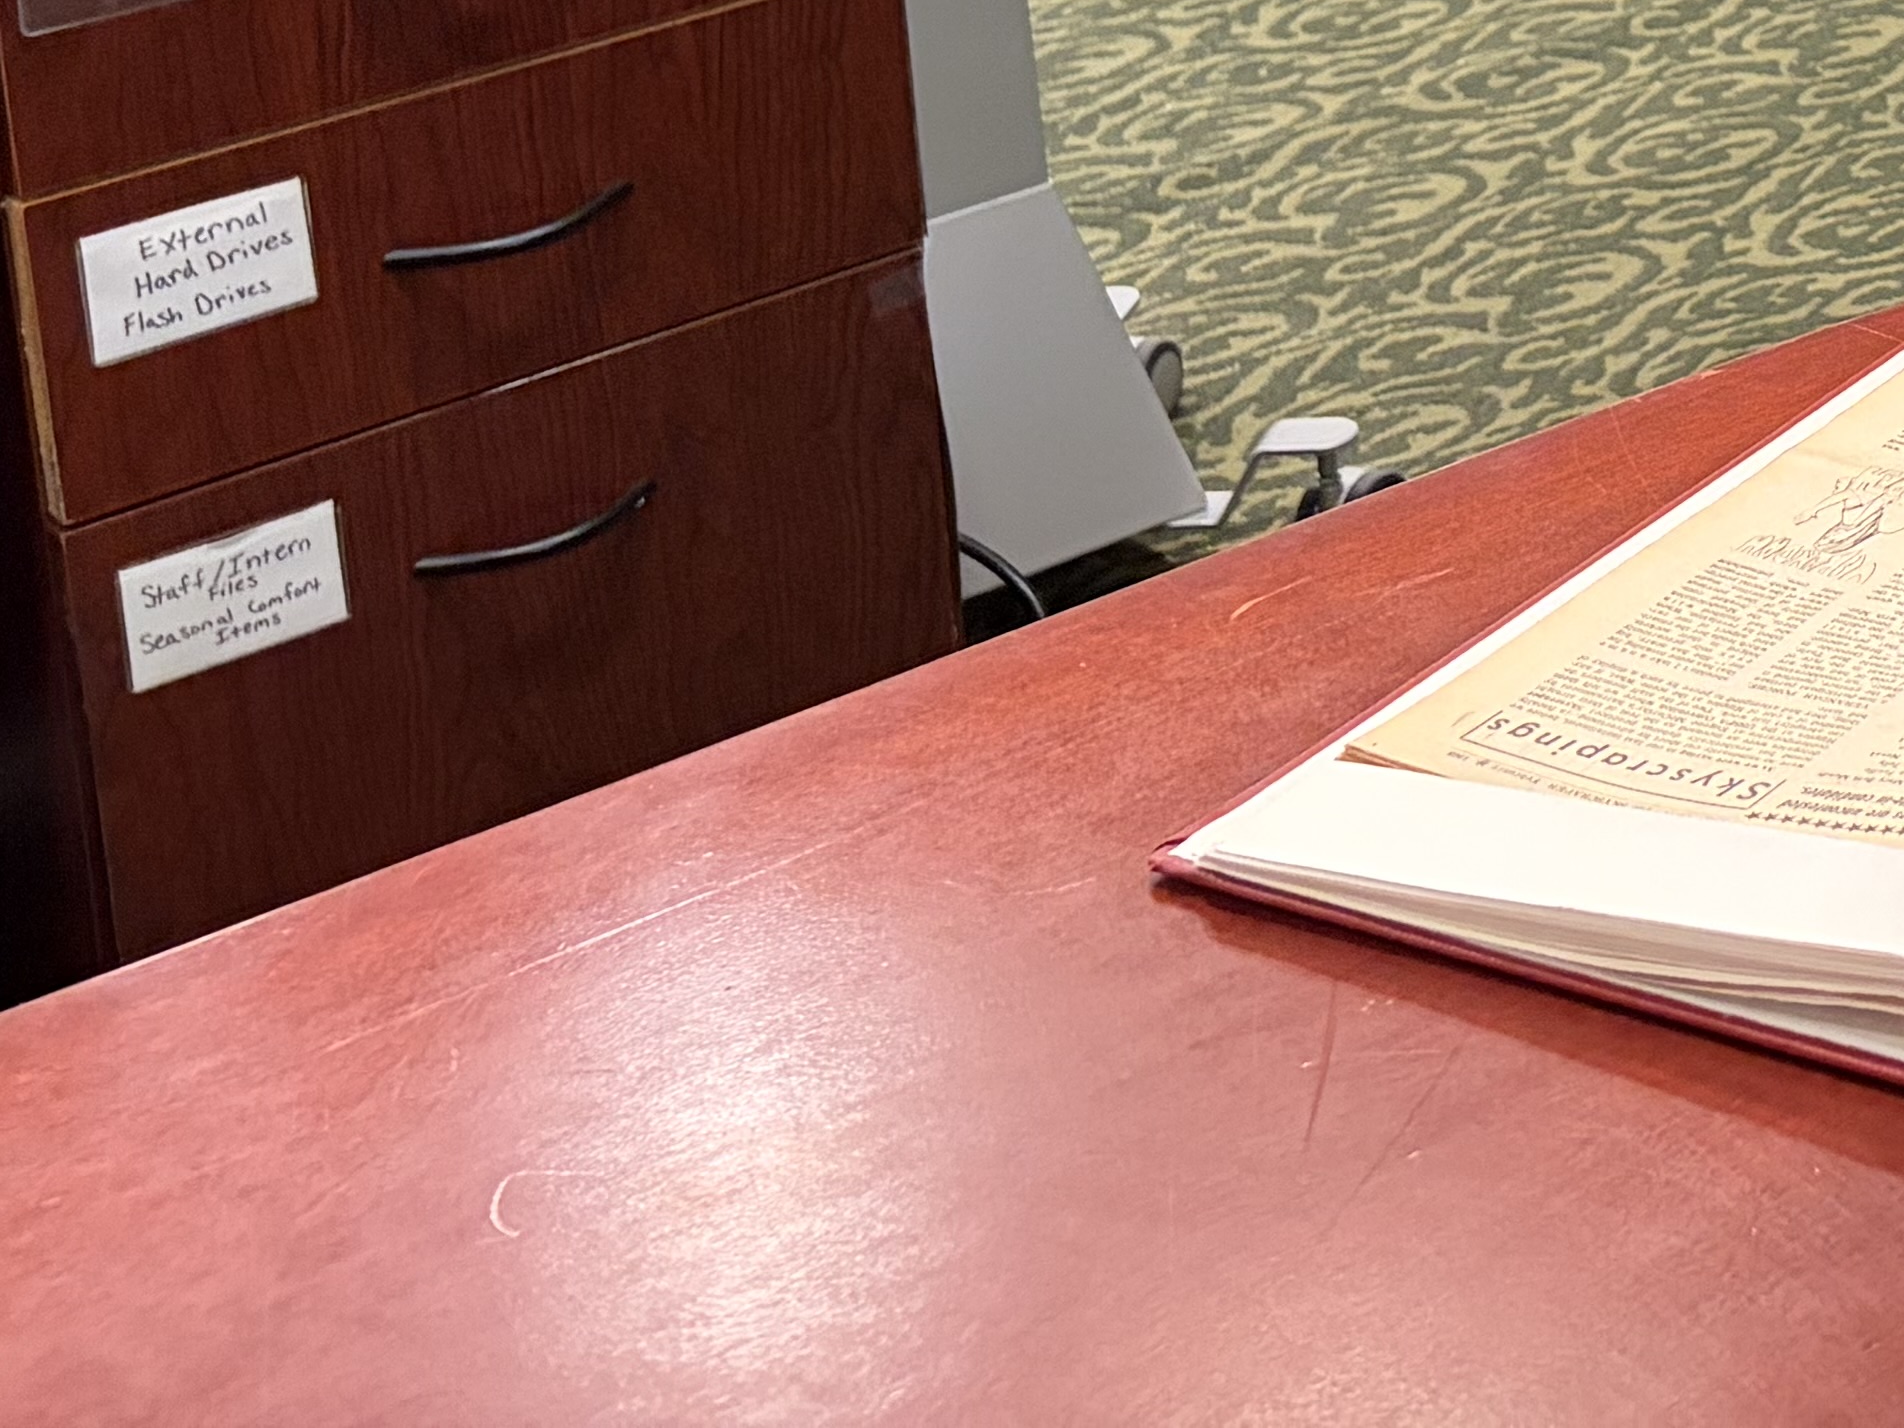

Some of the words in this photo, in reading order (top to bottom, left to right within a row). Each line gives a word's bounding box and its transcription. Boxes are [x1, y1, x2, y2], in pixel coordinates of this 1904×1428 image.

[139, 202, 268, 261] External
[135, 260, 198, 298] Hard
[206, 230, 293, 271] Drives
[123, 307, 183, 336] Flash
[195, 279, 272, 316] Drives
[208, 575, 258, 601] Files
[139, 607, 234, 655] Seasonal
[216, 613, 282, 645] Items
[1486, 718, 1771, 800] Skyscrapings
[1776, 799, 1863, 816] uncontested
[1800, 786, 1875, 802] candidates.
[1865, 809, 1891, 818] are
